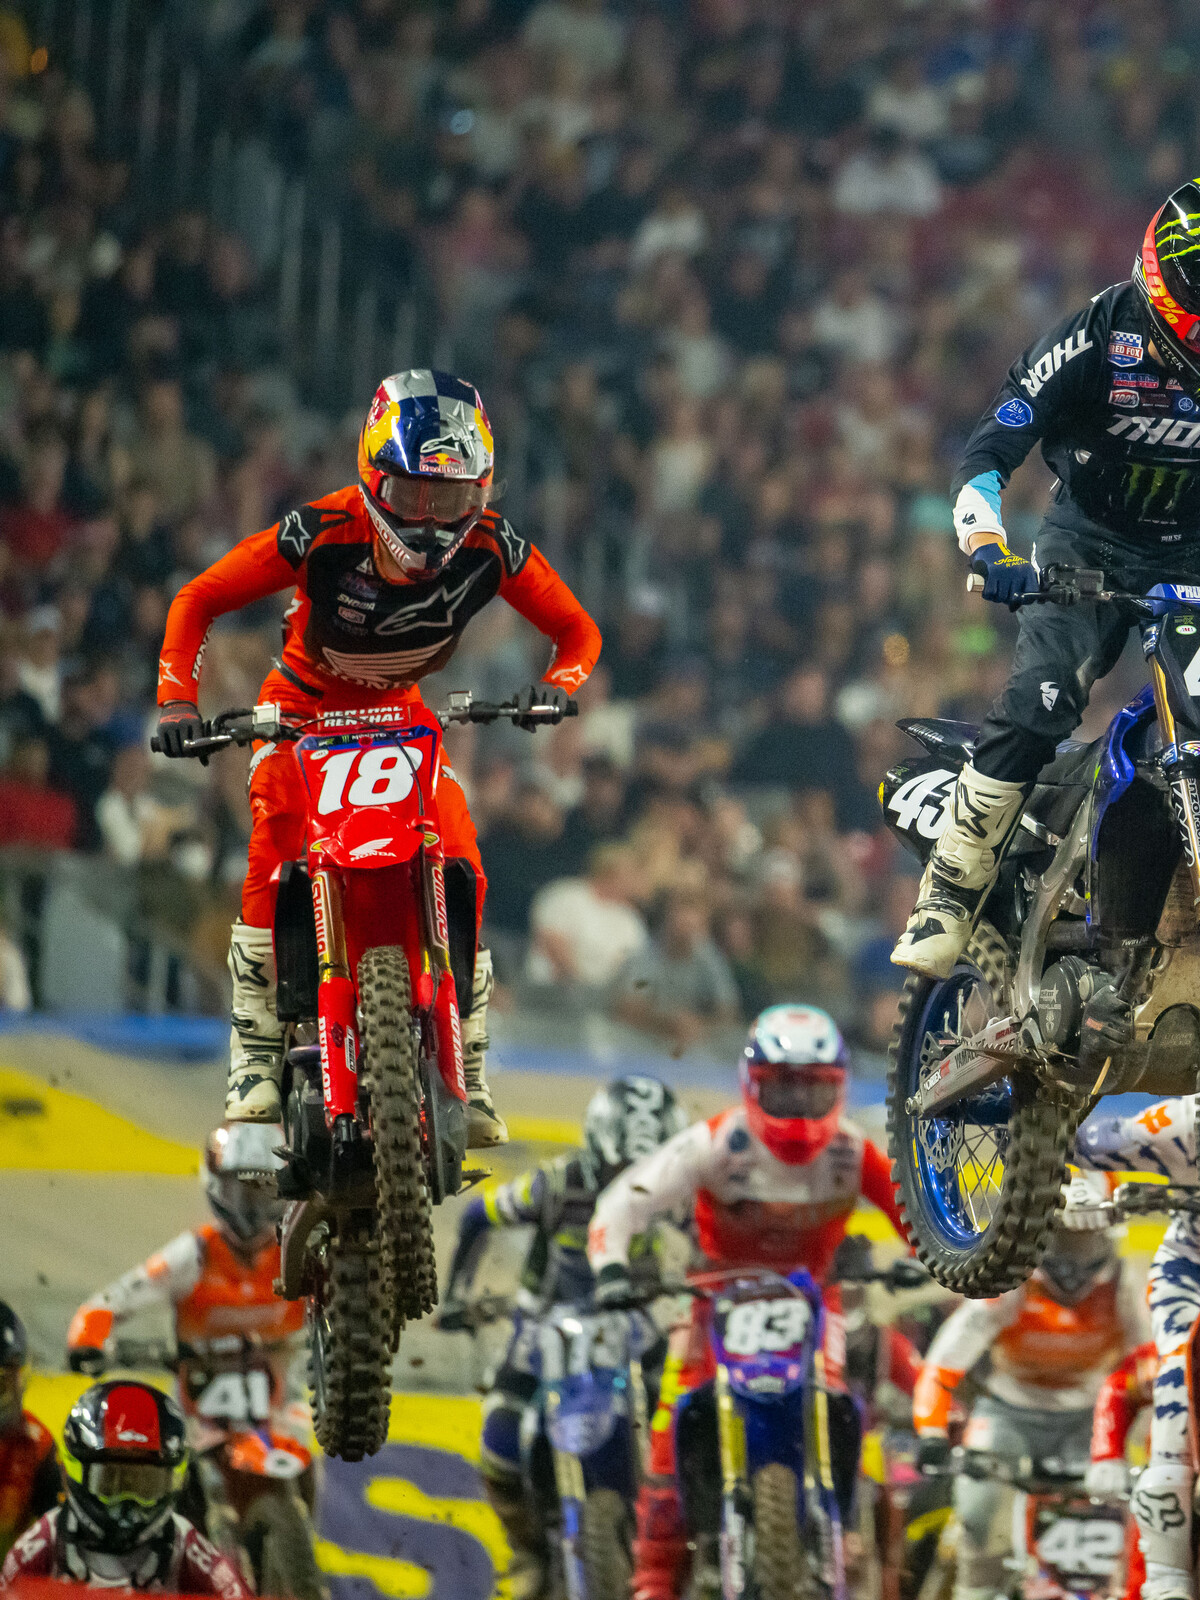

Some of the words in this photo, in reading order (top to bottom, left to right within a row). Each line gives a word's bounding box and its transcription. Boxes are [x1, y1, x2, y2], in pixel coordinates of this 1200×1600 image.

[1020, 328, 1093, 398] THOR
[1126, 346, 1141, 359] FOX
[1114, 393, 1137, 405] 100%
[337, 592, 376, 611] SHOWA
[317, 745, 424, 816] 18
[350, 850, 397, 862] HONDA
[311, 881, 328, 956] SHOWA
[432, 866, 448, 945] SHOWA
[1121, 937, 1139, 947] Twin
[318, 1016, 332, 1103] DUNLOP
[449, 1002, 467, 1094] DUNLOP
[923, 1068, 942, 1091] VORTEX
[199, 1370, 271, 1420] 41
[1036, 1517, 1124, 1575] 42
